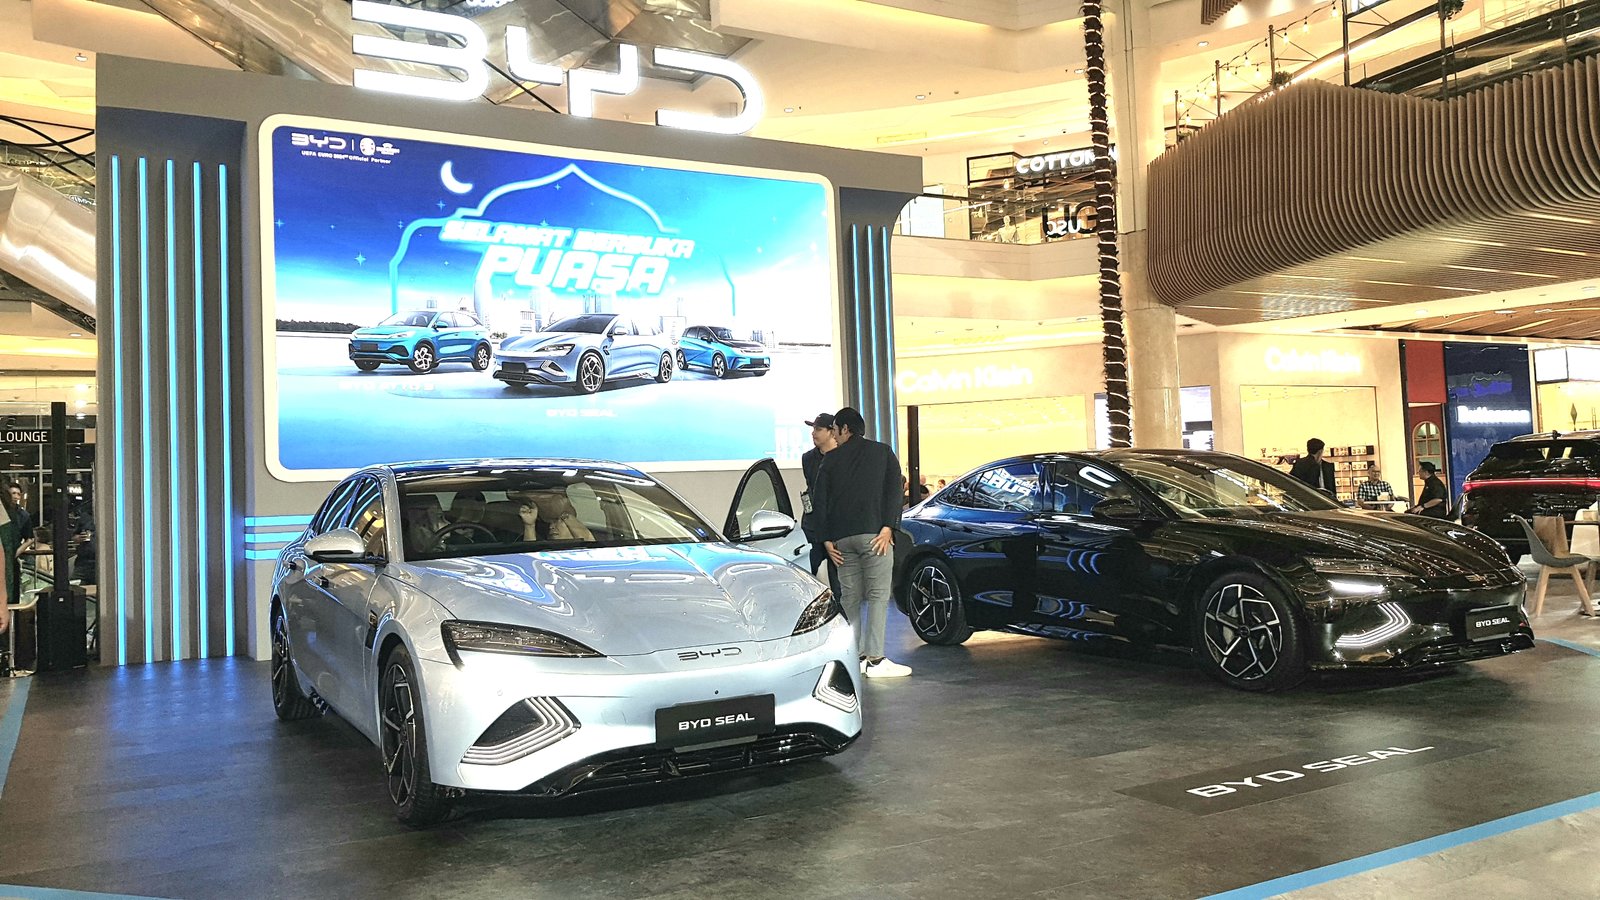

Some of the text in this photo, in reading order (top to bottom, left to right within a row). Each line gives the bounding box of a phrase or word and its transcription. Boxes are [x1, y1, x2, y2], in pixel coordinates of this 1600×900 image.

[351, 0, 764, 135] BYD
[291, 132, 347, 150] BYD
[1015, 149, 1096, 174] COTTON
[441, 220, 573, 248] SELAMAT
[475, 244, 671, 294] PUASA
[896, 368, 971, 393] Calvin
[0, 431, 48, 443] LOUNGE
[1475, 617, 1511, 628] BYD SEAL
[677, 646, 742, 661] BYD
[678, 712, 756, 731] BYD SEAL
[1186, 746, 1435, 798] BYD SEAL
